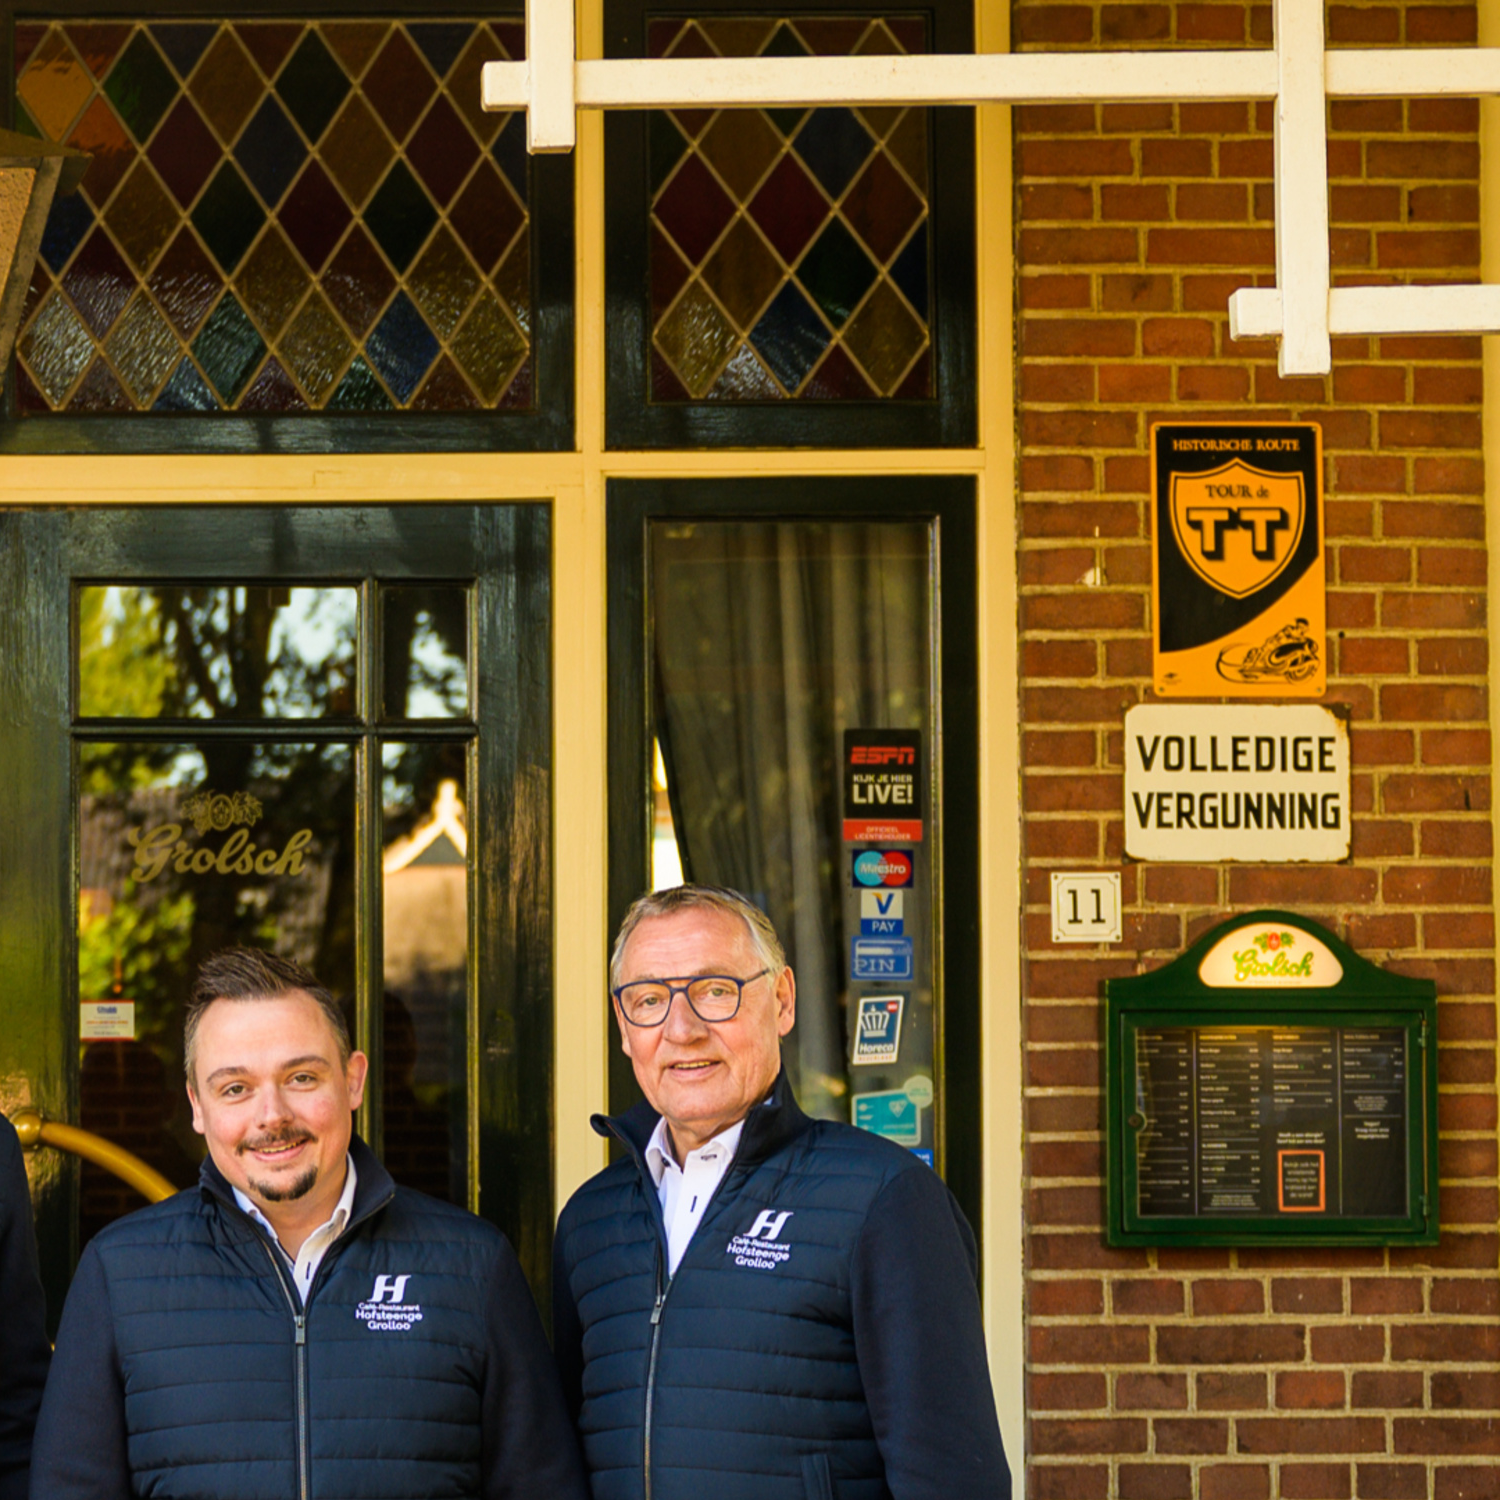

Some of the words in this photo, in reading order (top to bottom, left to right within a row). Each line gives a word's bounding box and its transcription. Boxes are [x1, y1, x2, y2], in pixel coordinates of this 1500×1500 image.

[1172, 439, 1252, 451] HISTORISCHE
[1256, 439, 1300, 451] ROUTE
[1205, 484, 1252, 498] TOUR
[1256, 485, 1270, 498] de
[1186, 507, 1290, 561] TT
[851, 746, 915, 764] ESPN
[1136, 735, 1337, 773] VOLLEDIGE
[853, 774, 875, 783] KIJK
[877, 774, 889, 783] JE
[891, 774, 913, 783] HIER
[853, 784, 913, 804] LIVE!
[1132, 792, 1341, 830] VERGUNNING
[127, 823, 313, 882] Grolsch
[860, 864, 906, 874] Maestro
[1067, 888, 1107, 925] 11
[872, 921, 896, 932] PAY
[853, 959, 895, 972] PIN
[1233, 949, 1314, 981] Grolsch
[859, 1043, 894, 1054] Horeca
[742, 1209, 794, 1240] H
[726, 1242, 789, 1262] Hofsteenge
[735, 1255, 775, 1269] Grolloo
[366, 1274, 411, 1303] H
[355, 1309, 423, 1322] Hofsteenge
[367, 1320, 411, 1330] Grolloo
